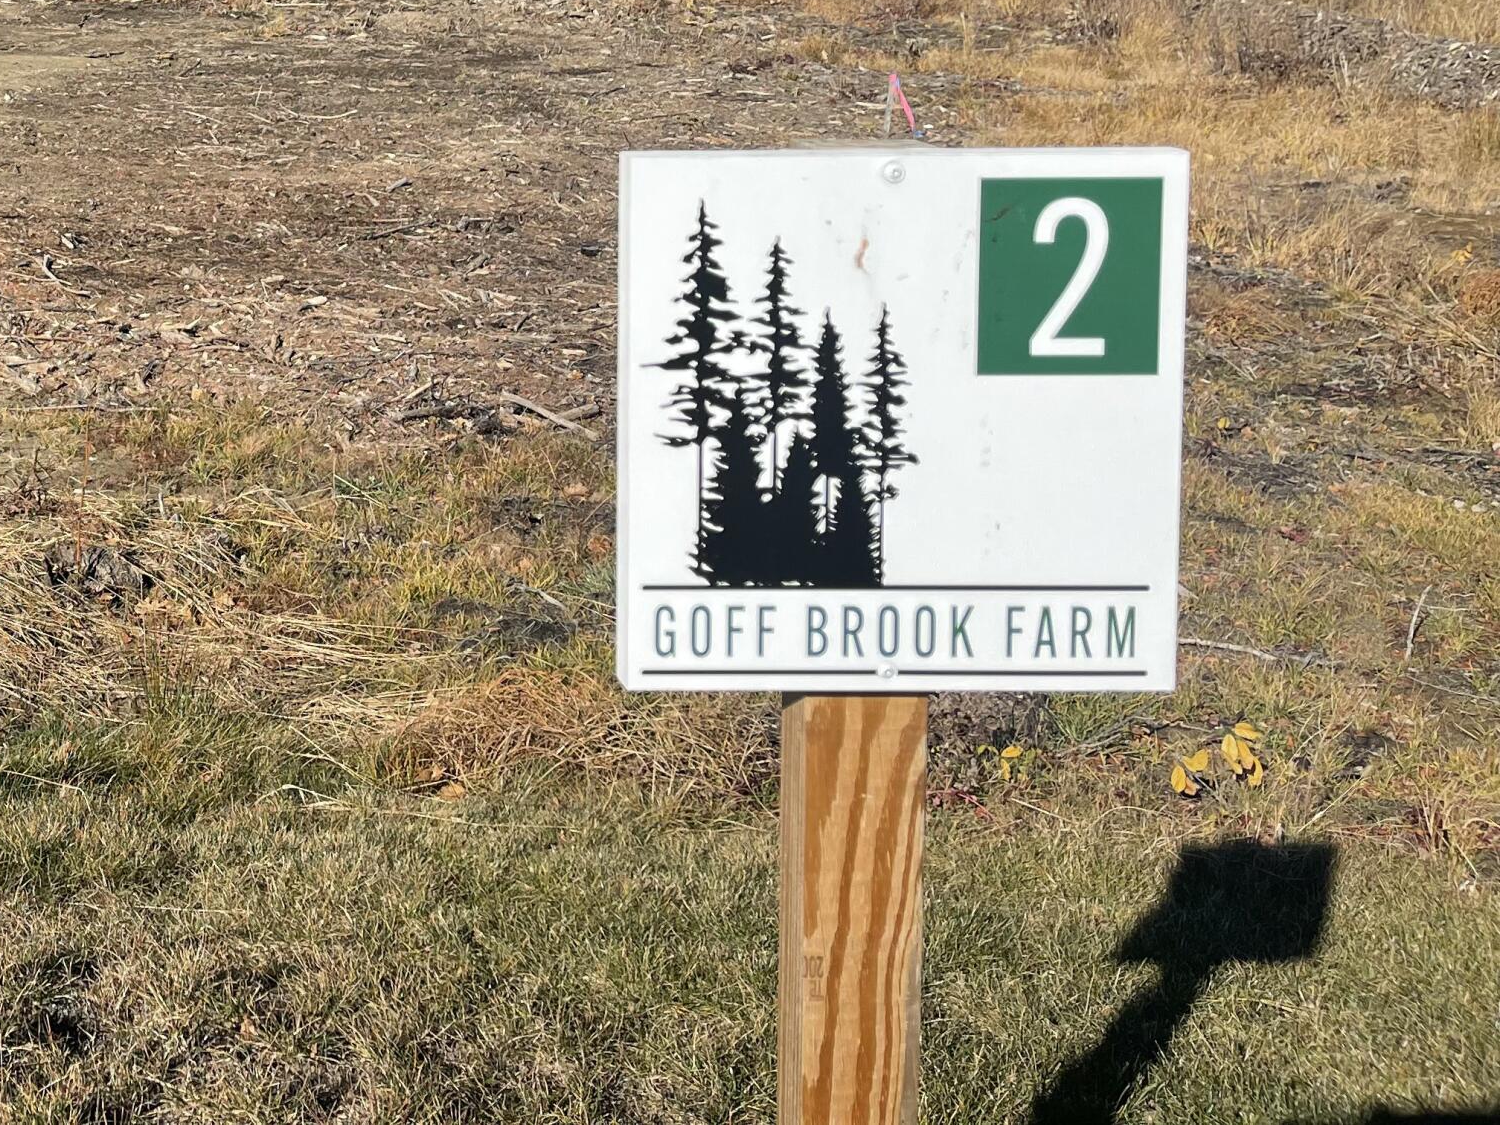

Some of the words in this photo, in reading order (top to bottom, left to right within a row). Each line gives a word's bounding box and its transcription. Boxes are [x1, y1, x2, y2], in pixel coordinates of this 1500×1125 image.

[1029, 196, 1110, 356] 2
[654, 604, 777, 658] GOFF
[806, 605, 974, 658] BROOK
[1005, 605, 1137, 659] FARM
